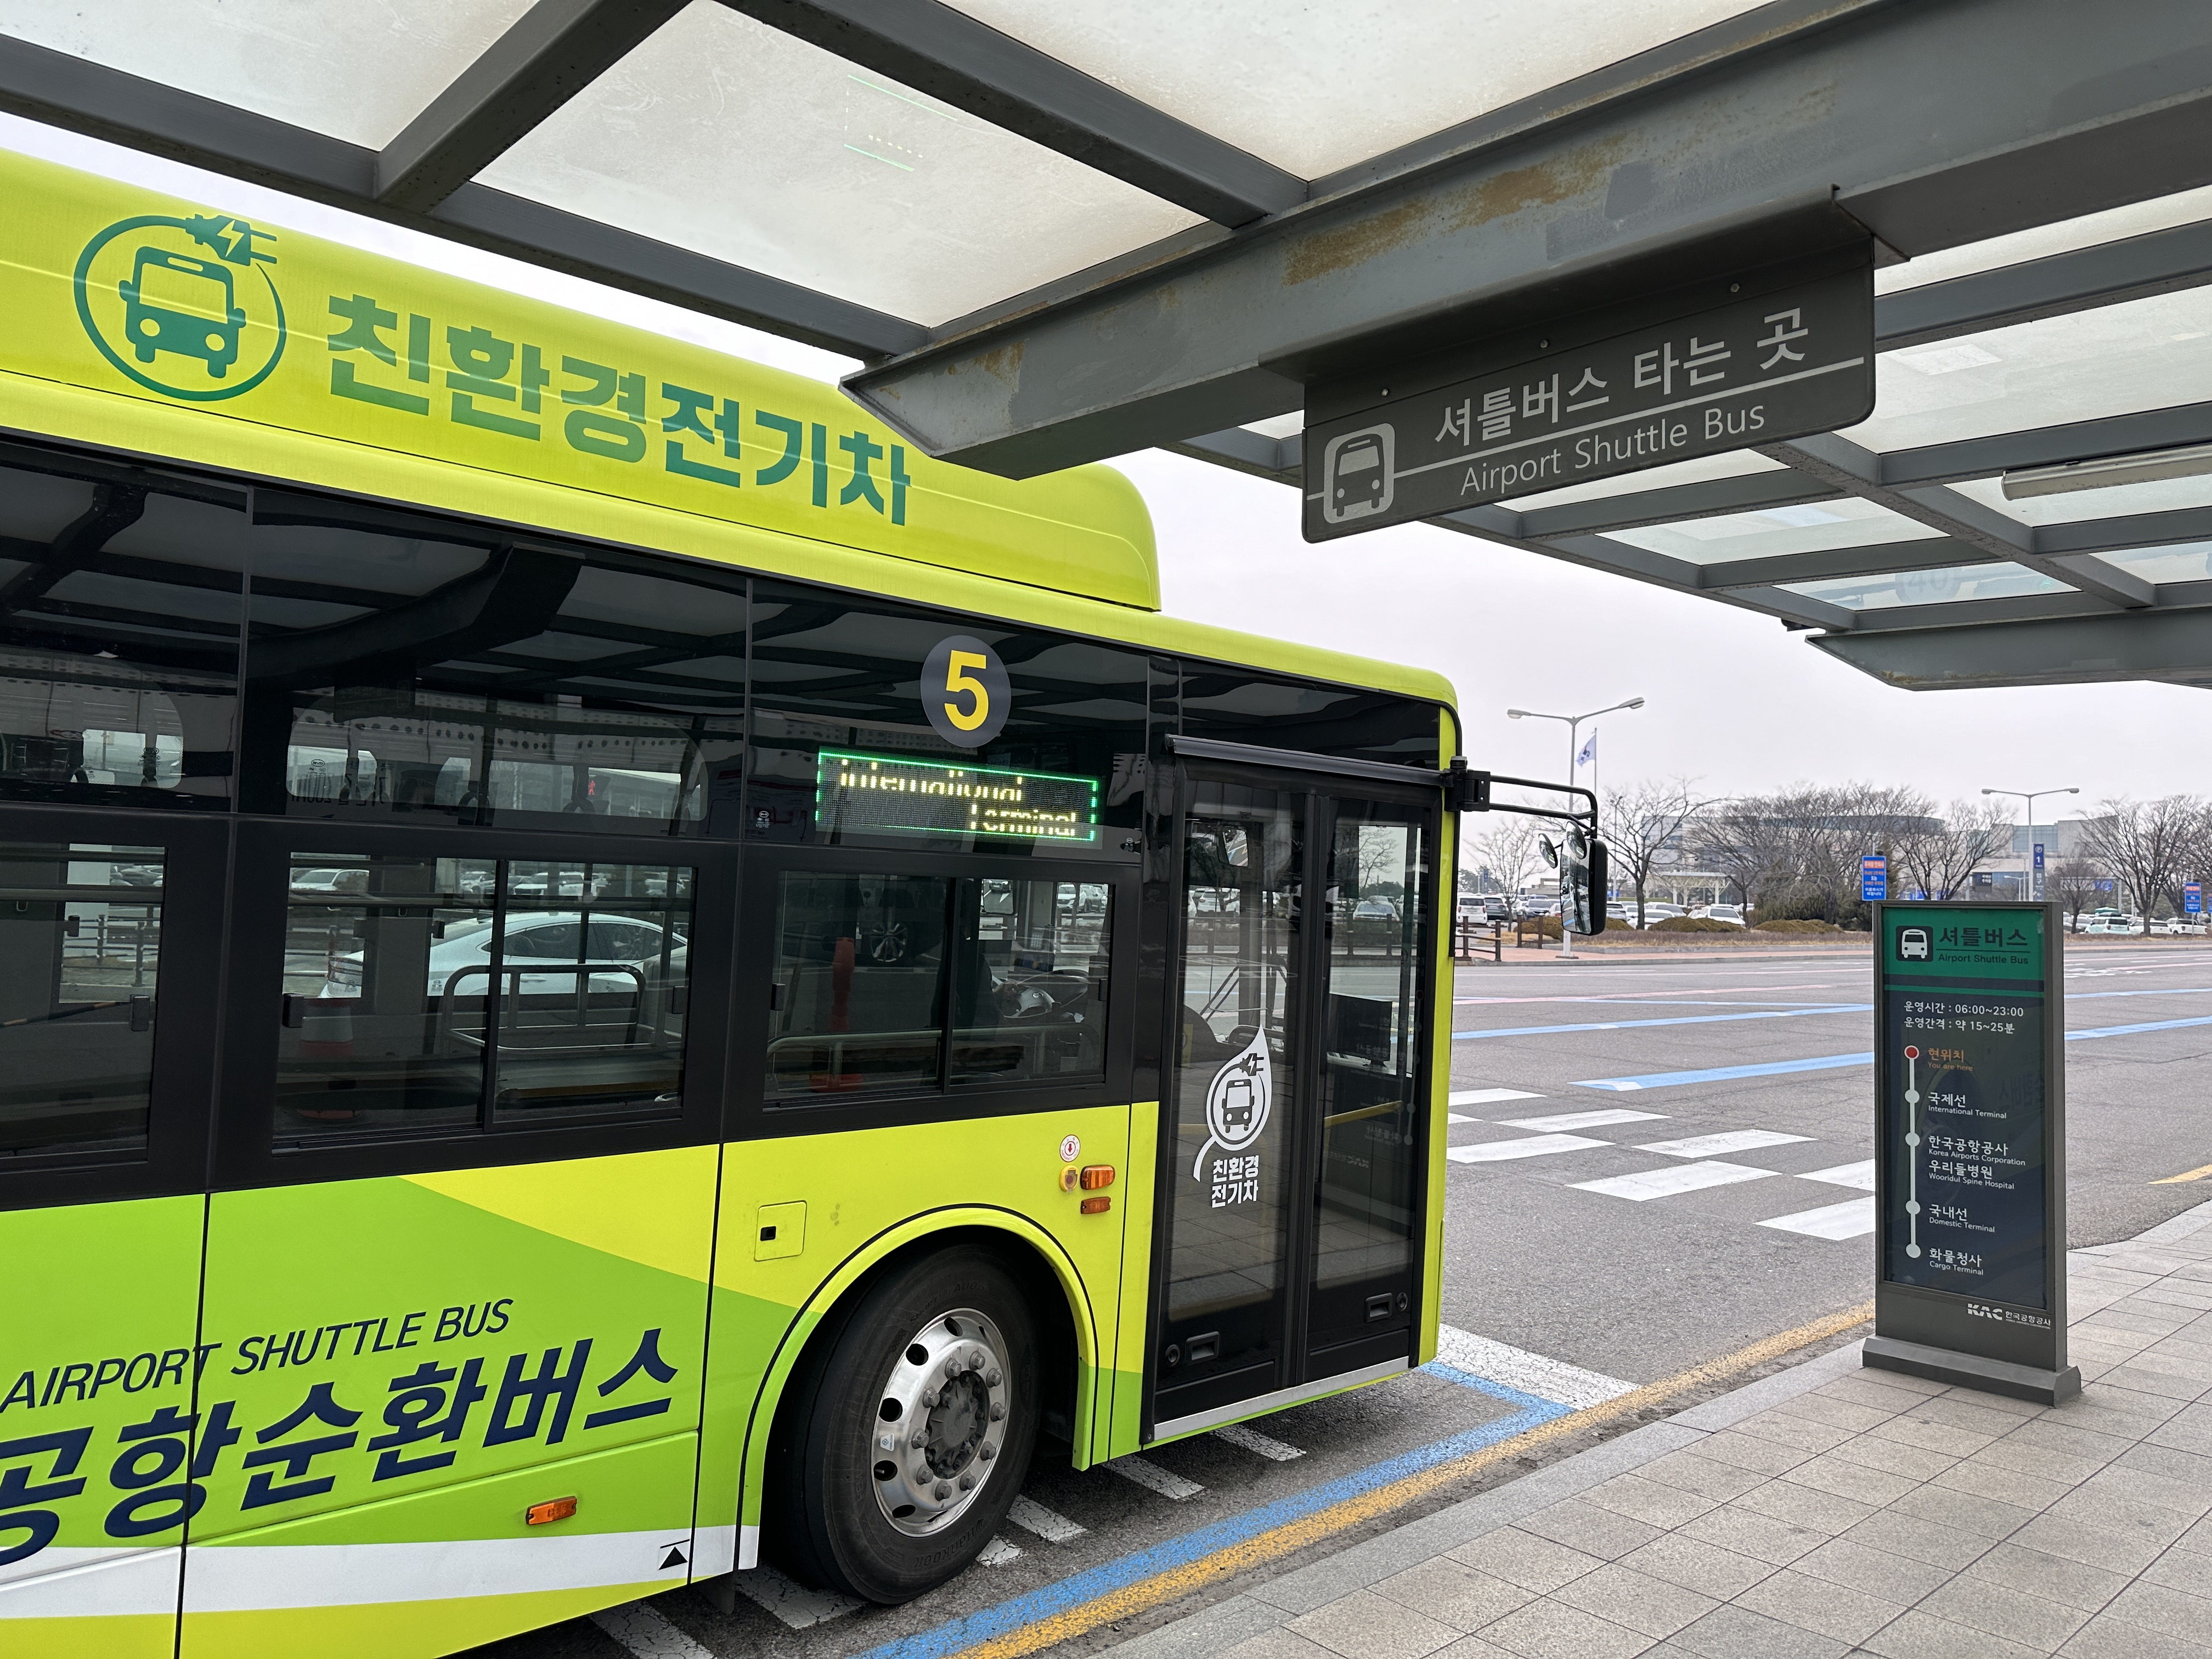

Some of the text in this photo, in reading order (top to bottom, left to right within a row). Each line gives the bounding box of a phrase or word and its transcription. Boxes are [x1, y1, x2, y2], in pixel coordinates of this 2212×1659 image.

[1435, 307, 1809, 447] 셔틀버스 타는 곳
[328, 294, 912, 526] 친환경전기차
[1460, 405, 1765, 495] Airport Shuttle Bus
[944, 650, 989, 731] 5
[1939, 927, 2028, 947] 셔틀버스
[1938, 953, 2029, 964] Airport Shuttle Bus
[1904, 1001, 1945, 1014] 운영시간
[1955, 1004, 2024, 1017] 06:00~23:00
[1904, 1017, 1945, 1030] 운영간격
[1955, 1019, 1966, 1031] 약
[1970, 1021, 2016, 1035] 15~25분
[1928, 1048, 1965, 1063] 현위치
[1928, 1092, 1966, 1108] 국제선
[1928, 1104, 2007, 1119] International Terminal
[1928, 1135, 2009, 1156] 한국공항공사
[1929, 1148, 2026, 1166] Korea Airports Corporation
[1212, 1155, 1260, 1183] 친환경
[1928, 1160, 1993, 1180] 우리들병원
[1929, 1172, 2015, 1190] Wooridul Spine Hospital
[1211, 1180, 1259, 1209] 전기차
[1928, 1204, 1967, 1222] 국내선
[1929, 1216, 1995, 1233] Domestic Terminal
[1929, 1248, 1982, 1268] 화물청사
[1929, 1260, 1984, 1276] Cargo Terminal
[1967, 1303, 2002, 1321] KAC
[2005, 1311, 2051, 1326] 한국공항공사
[0, 1298, 515, 1413] AIRPORT SHUTTLE BUS
[0, 1328, 679, 1566] 공항순환버스
